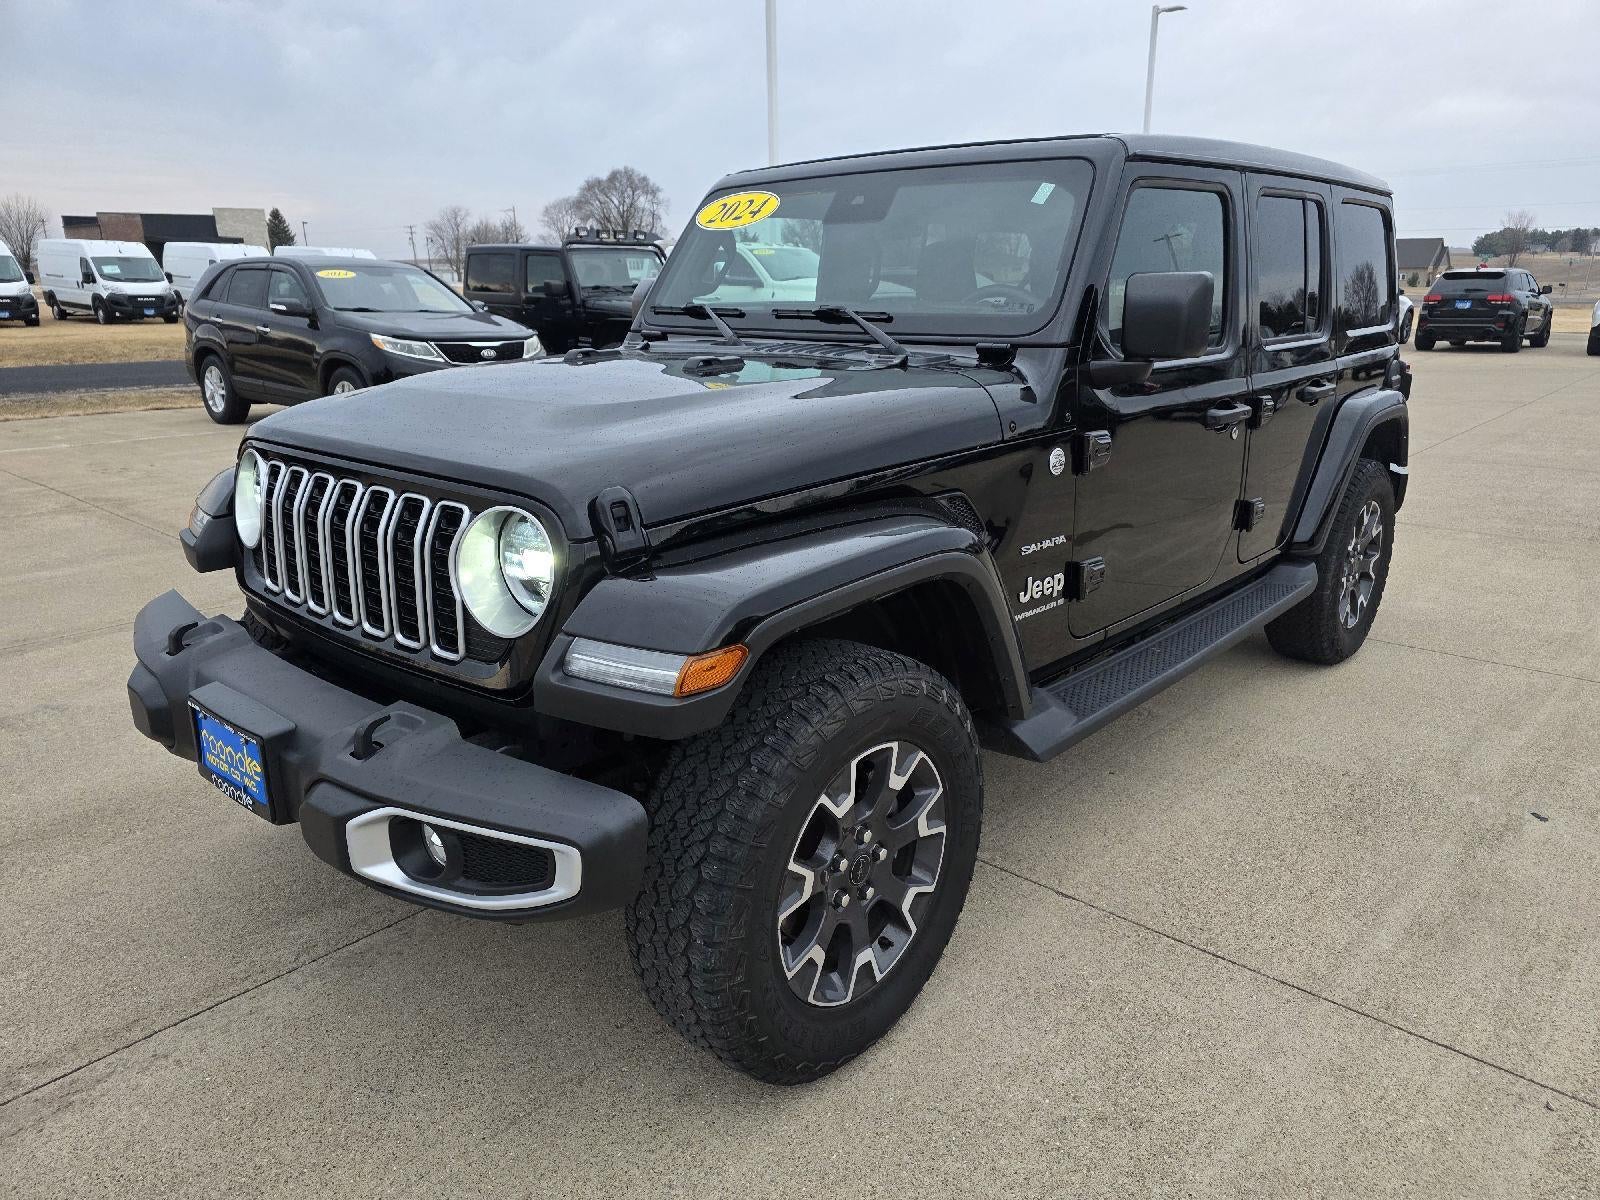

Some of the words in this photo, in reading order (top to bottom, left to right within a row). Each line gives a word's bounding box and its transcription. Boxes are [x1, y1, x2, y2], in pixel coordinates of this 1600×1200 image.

[705, 197, 772, 224] 2024
[1021, 535, 1067, 556] SAHARA
[1019, 572, 1065, 604] Jeep
[1014, 601, 1057, 622] WRANGLER
